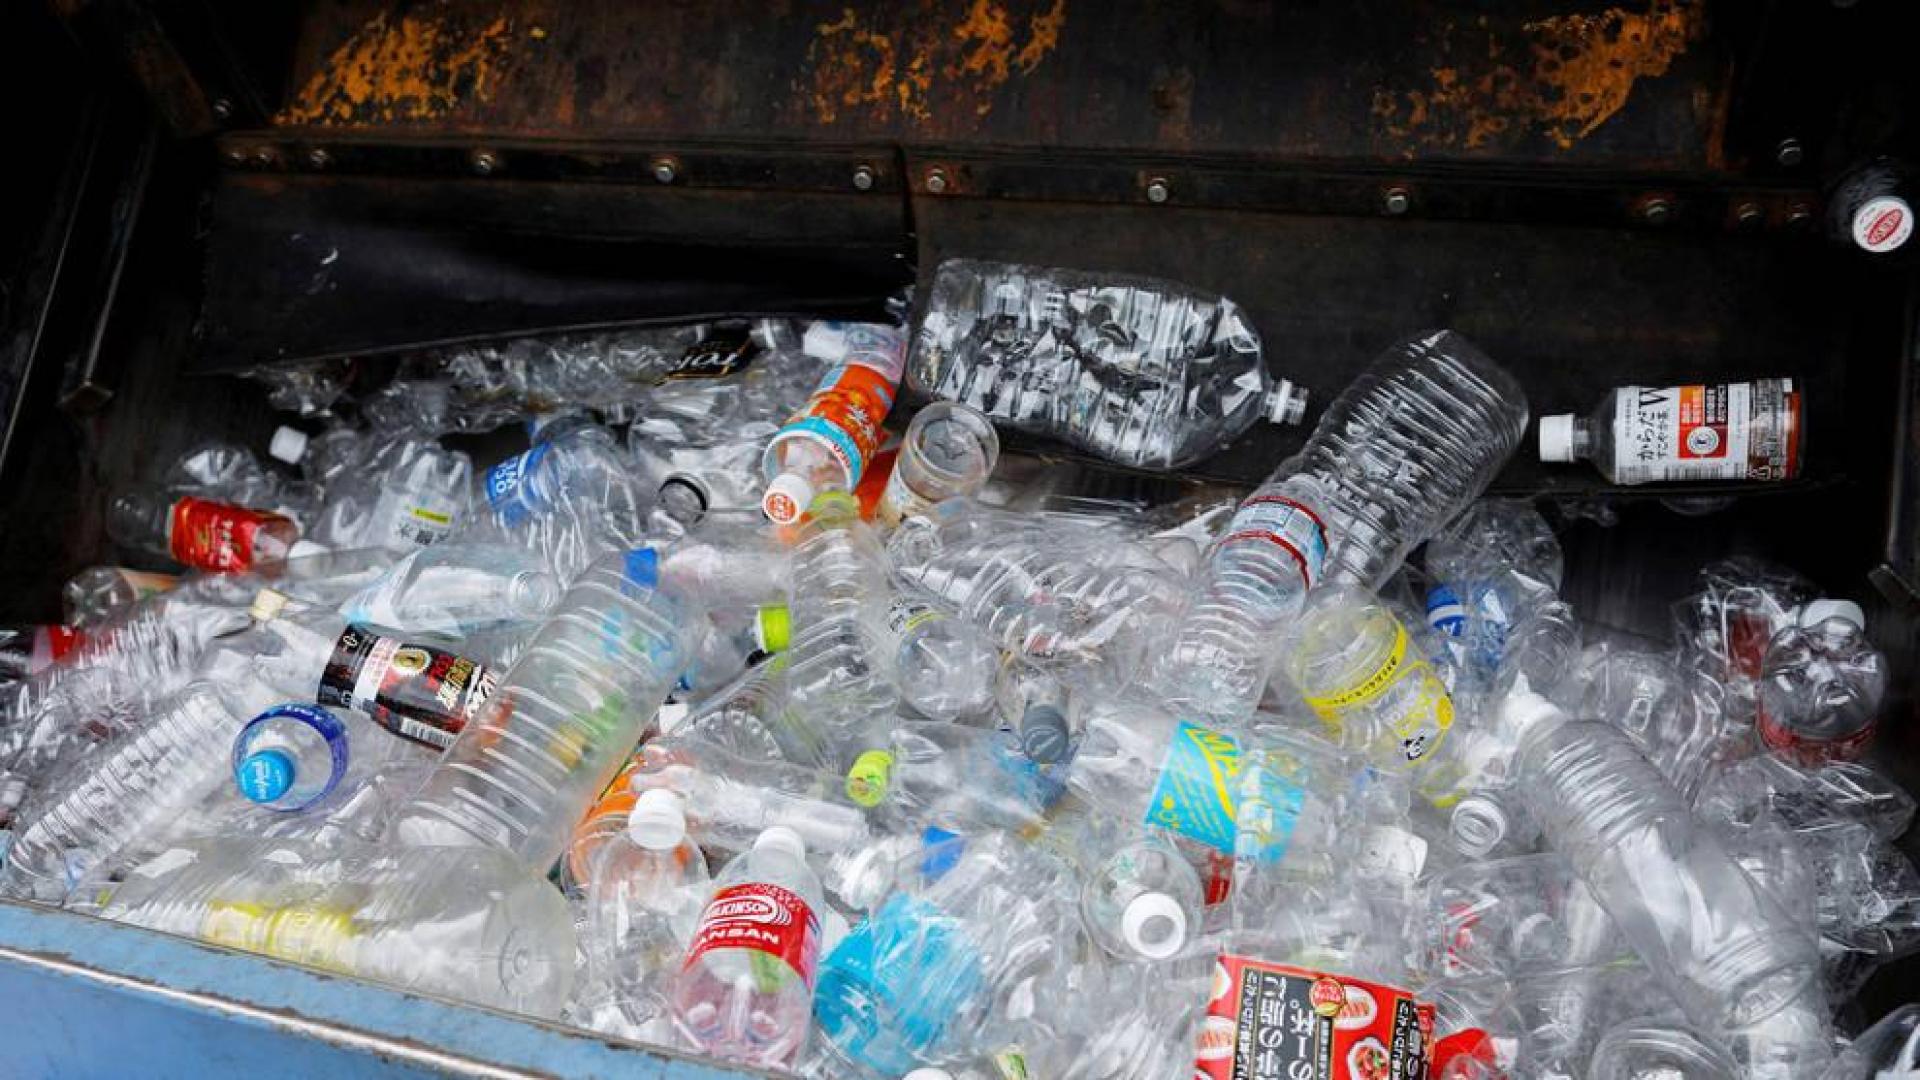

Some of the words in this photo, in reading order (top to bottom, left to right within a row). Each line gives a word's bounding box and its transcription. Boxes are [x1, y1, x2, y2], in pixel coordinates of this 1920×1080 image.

[1636, 410, 1655, 461] からだ
[1256, 976, 1287, 1080] 事の脂に
